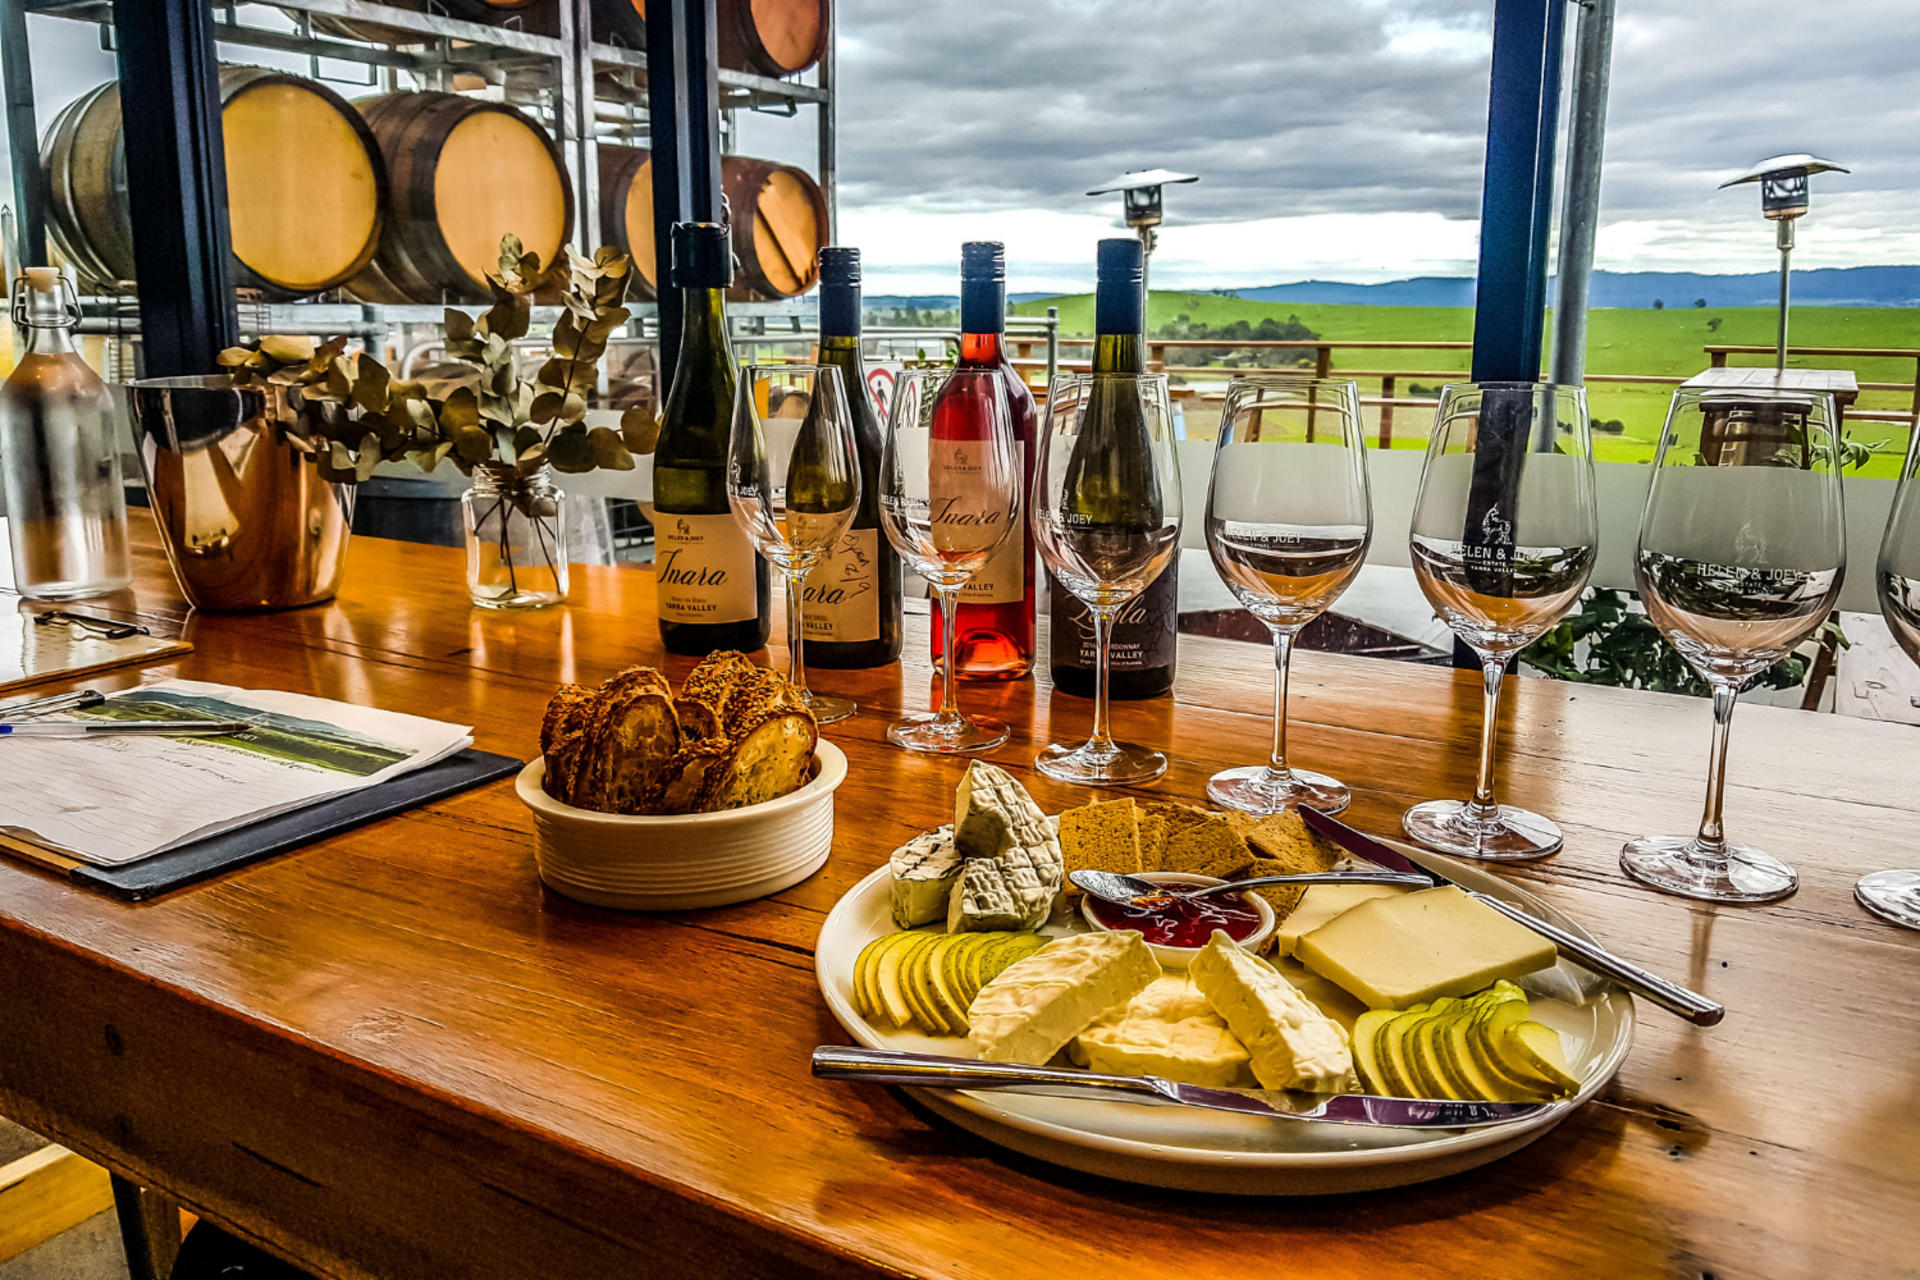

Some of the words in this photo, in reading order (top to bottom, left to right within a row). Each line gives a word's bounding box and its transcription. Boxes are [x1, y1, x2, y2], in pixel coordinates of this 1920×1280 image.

[931, 496, 1001, 526] Inara
[1067, 512, 1093, 525] JOEY
[1260, 532, 1270, 543] &
[1449, 543, 1492, 559] HELEN
[1495, 548, 1506, 561] &
[657, 549, 729, 587] Inara
[1750, 567, 1761, 581] &
[1765, 568, 1804, 581] JOEY
[1079, 649, 1096, 658] YAR
[1110, 651, 1144, 660] VALLEY
